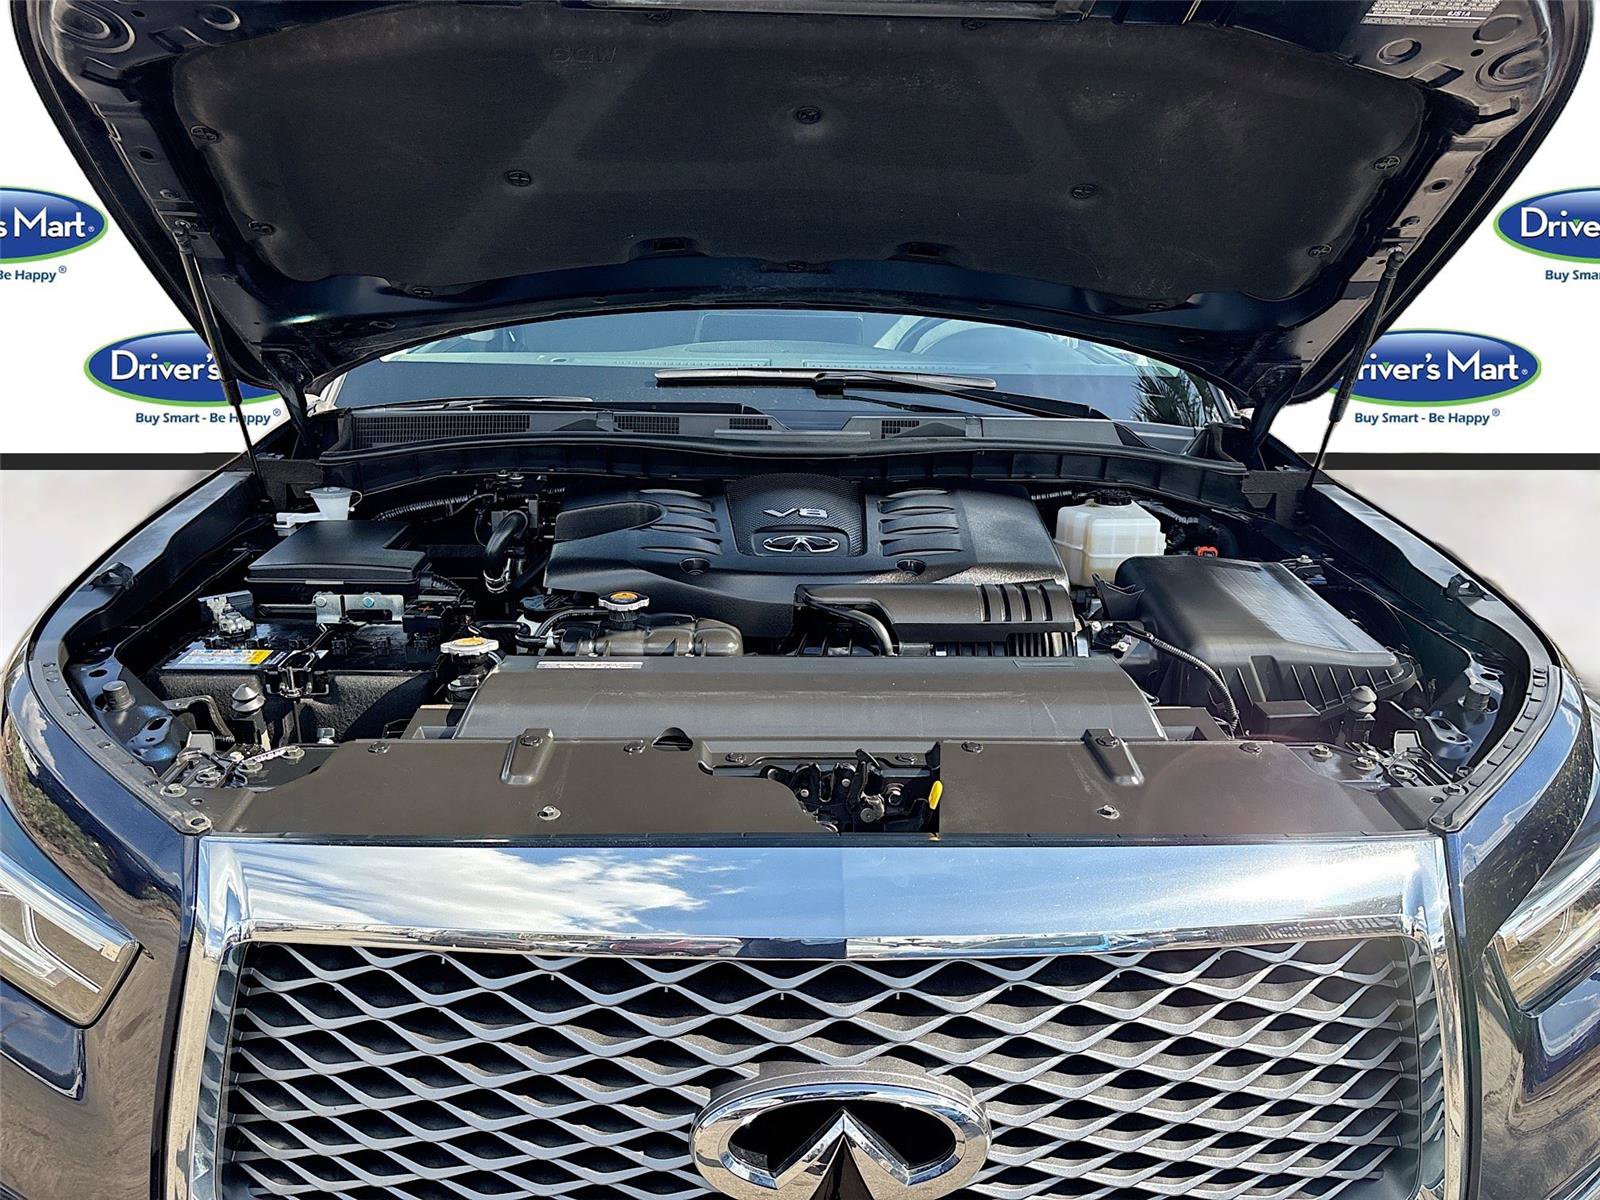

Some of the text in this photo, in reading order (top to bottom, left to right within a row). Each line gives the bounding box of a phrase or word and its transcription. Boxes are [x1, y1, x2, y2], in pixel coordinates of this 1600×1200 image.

[14, 206, 86, 238] Mart
[1521, 206, 1600, 238] Drive
[15, 269, 57, 283] Happy
[1545, 269, 1600, 283] Buy Sma
[111, 349, 222, 381] Driver's
[1357, 349, 1519, 381] river's Mart
[135, 412, 160, 425] Buy
[163, 412, 200, 424] Smart
[210, 412, 226, 424] Be
[1355, 412, 1379, 426] Buy
[1382, 412, 1419, 424] Smart
[1429, 412, 1445, 424] Be
[1448, 412, 1490, 426] Happy
[763, 507, 829, 519] V8
